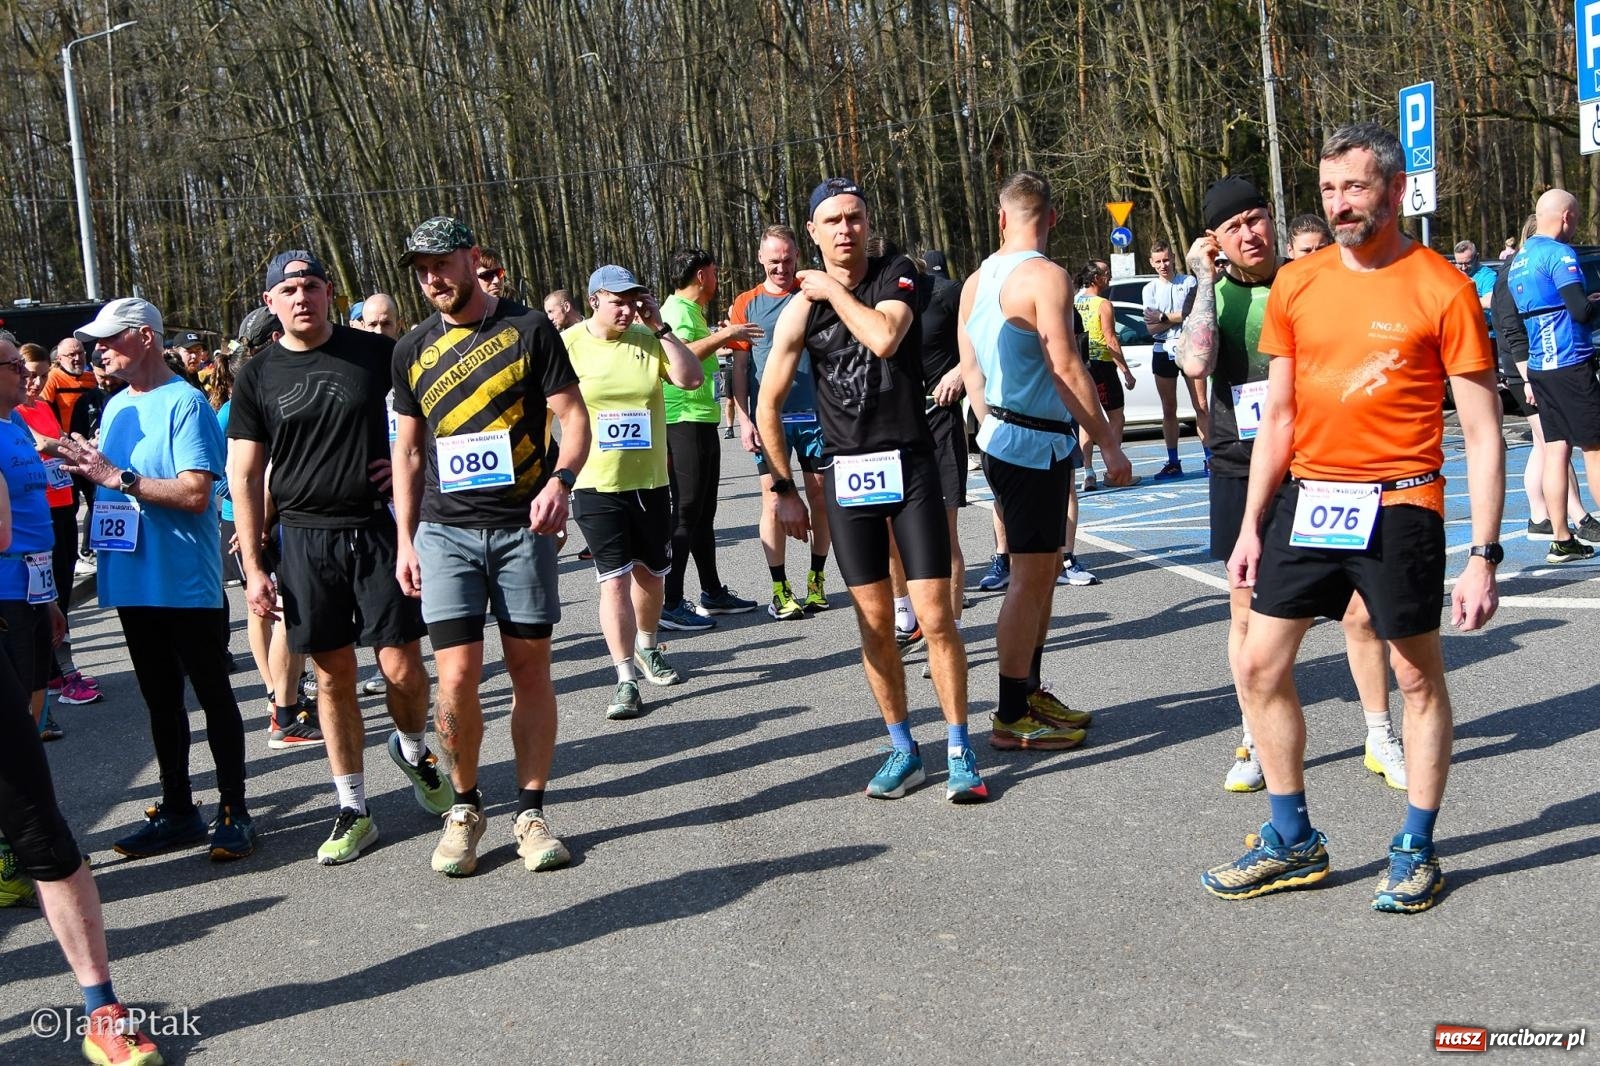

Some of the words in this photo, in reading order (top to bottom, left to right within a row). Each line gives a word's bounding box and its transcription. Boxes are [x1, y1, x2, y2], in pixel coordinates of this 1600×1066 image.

[423, 337, 504, 410] RUNMAGEDDON
[608, 424, 641, 438] 072
[450, 451, 498, 474] 080
[848, 471, 885, 491] 051
[99, 518, 125, 537] 128
[1310, 505, 1360, 530] 076
